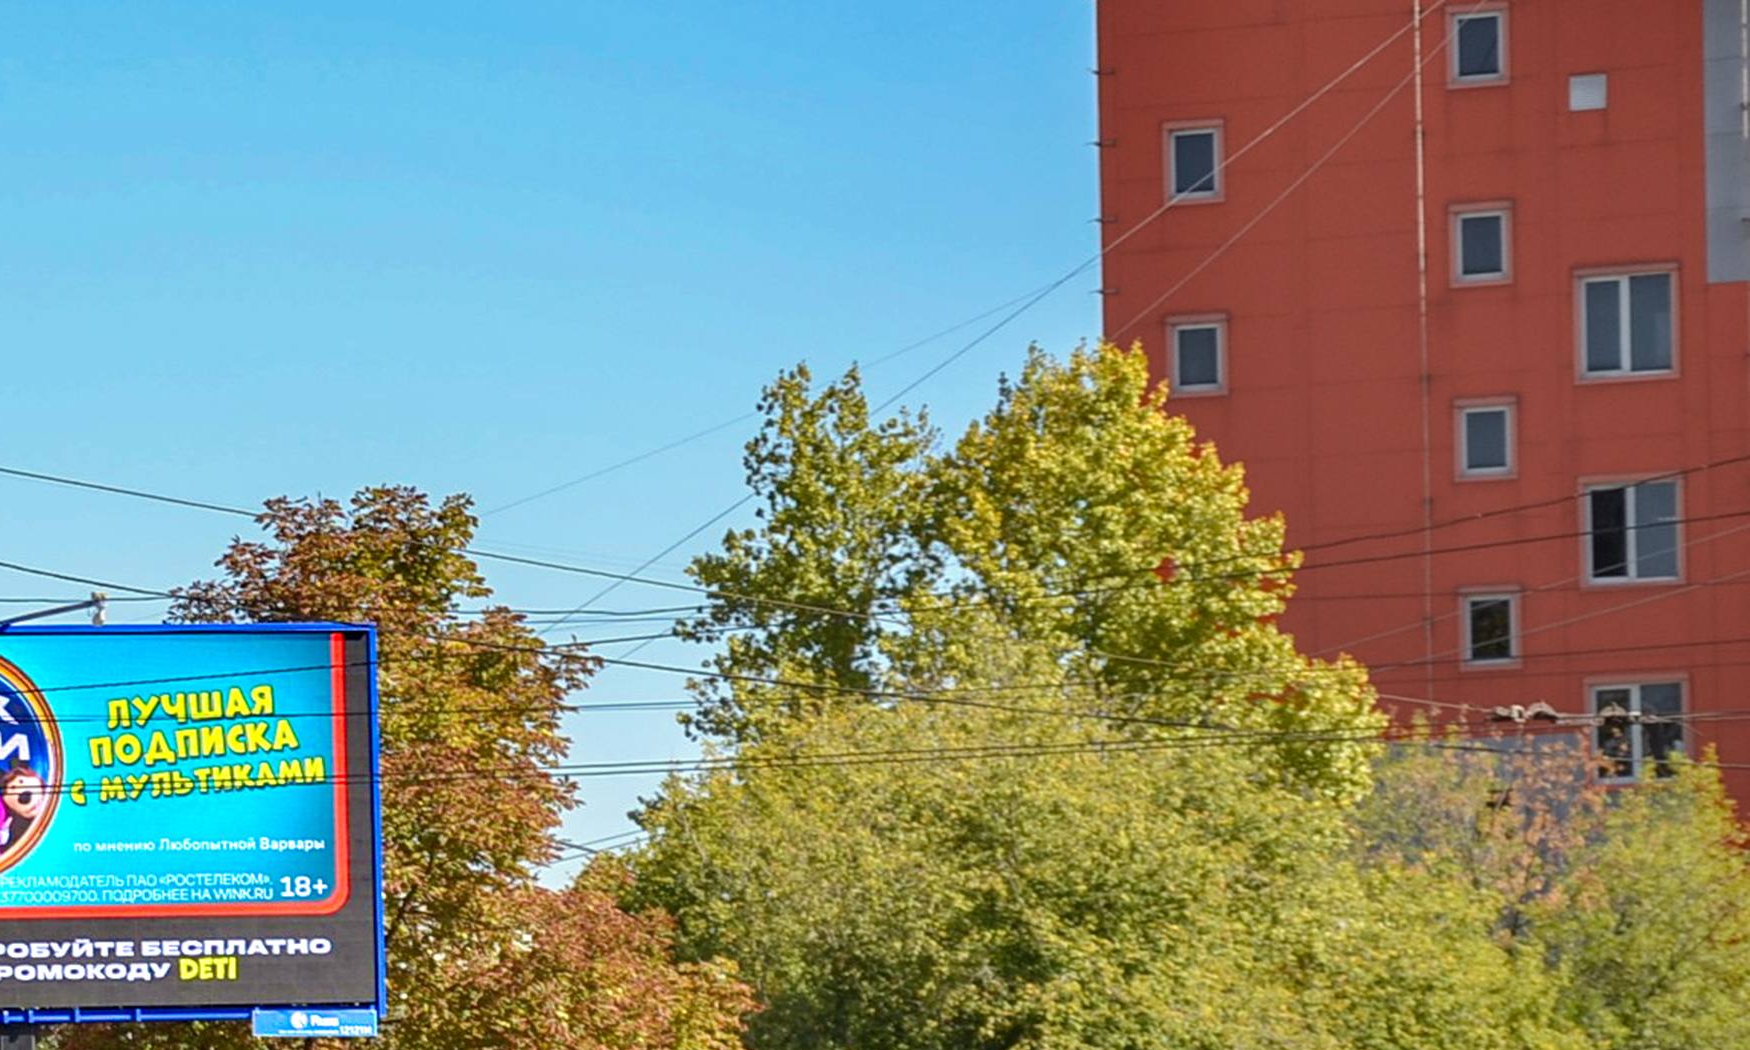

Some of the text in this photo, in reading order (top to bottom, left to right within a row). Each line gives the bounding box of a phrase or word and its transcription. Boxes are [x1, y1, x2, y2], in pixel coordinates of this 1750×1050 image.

[107, 685, 274, 730] ЛУЧШАЯ
[89, 719, 300, 766] ПОДПИСКА
[100, 757, 326, 803] МУЛЬТИКАМИ
[73, 837, 325, 852] по мнению Любопытной Варвары
[0, 874, 125, 889] РЕКЛАМОДАТЕЛЬ
[126, 874, 157, 887] ПАО
[279, 875, 329, 898] 18+
[102, 888, 189, 902] ПОДРОБНЕЕ
[191, 888, 210, 901] НА
[212, 887, 274, 900] WINK.RU
[140, 938, 332, 957] БЕСПЛАТНО
[178, 956, 238, 981] DETI
